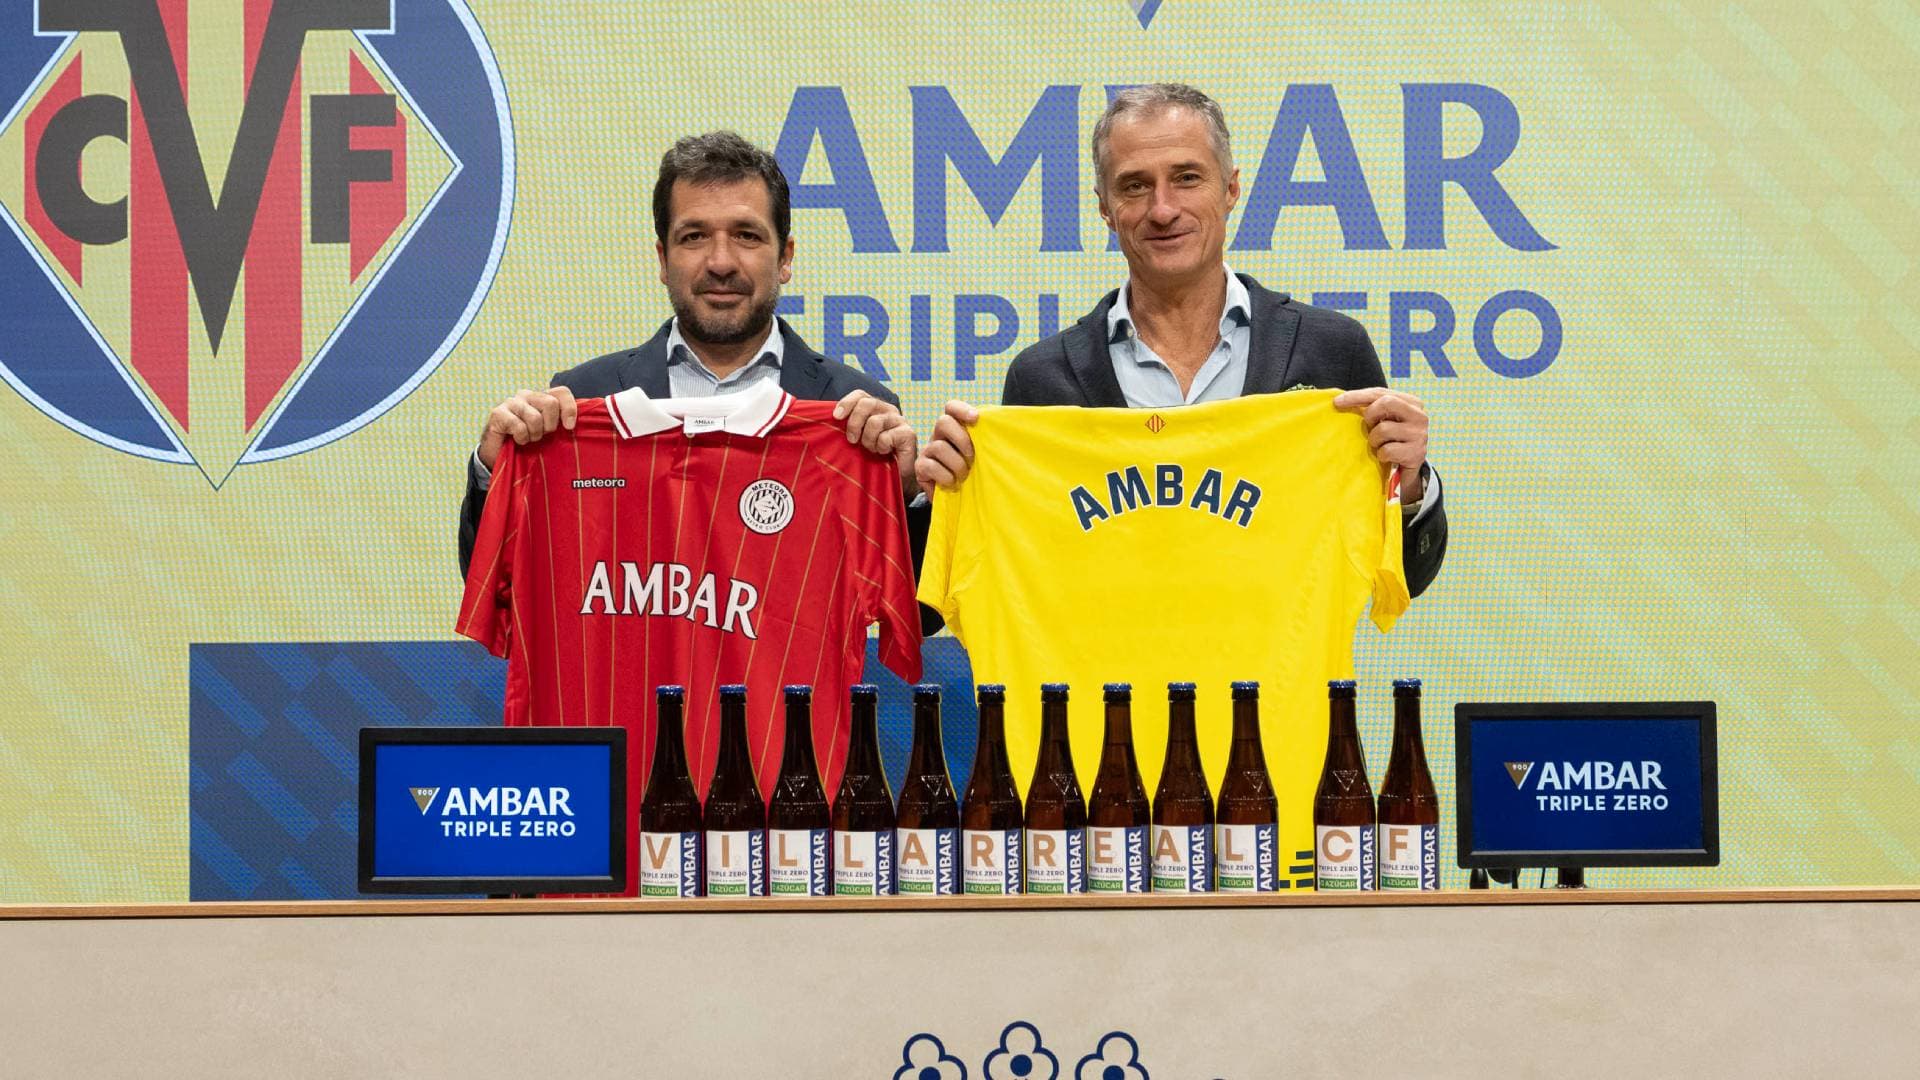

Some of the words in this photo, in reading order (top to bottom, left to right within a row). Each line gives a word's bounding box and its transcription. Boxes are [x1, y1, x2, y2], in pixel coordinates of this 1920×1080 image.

[773, 83, 1561, 253] AMAR
[572, 477, 625, 489] meteora
[752, 483, 788, 500] METEORA
[1068, 463, 1263, 533] AMBAR
[579, 560, 759, 640] AMBAR
[441, 787, 575, 817] AMBAR
[1536, 761, 1668, 791] AMBAR
[1536, 795, 1606, 811] TRIPLE
[1613, 794, 1668, 811] ZERO
[440, 820, 512, 837] TRIPLE
[519, 820, 576, 837] ZERO
[1191, 828, 1205, 892] AMBAR
[1258, 826, 1272, 890] AMBAR
[1362, 828, 1373, 891] AMBAR
[1424, 828, 1435, 891] AMBAR
[684, 834, 696, 897] AMBAR
[751, 832, 763, 896] AMBAR
[813, 831, 826, 896] AMBAR
[878, 834, 890, 896] AMBAR
[939, 831, 952, 895] AMBAR
[1007, 832, 1019, 895] AMBAR
[1069, 831, 1082, 894] AMBAR
[1128, 829, 1142, 893] AMBAR
